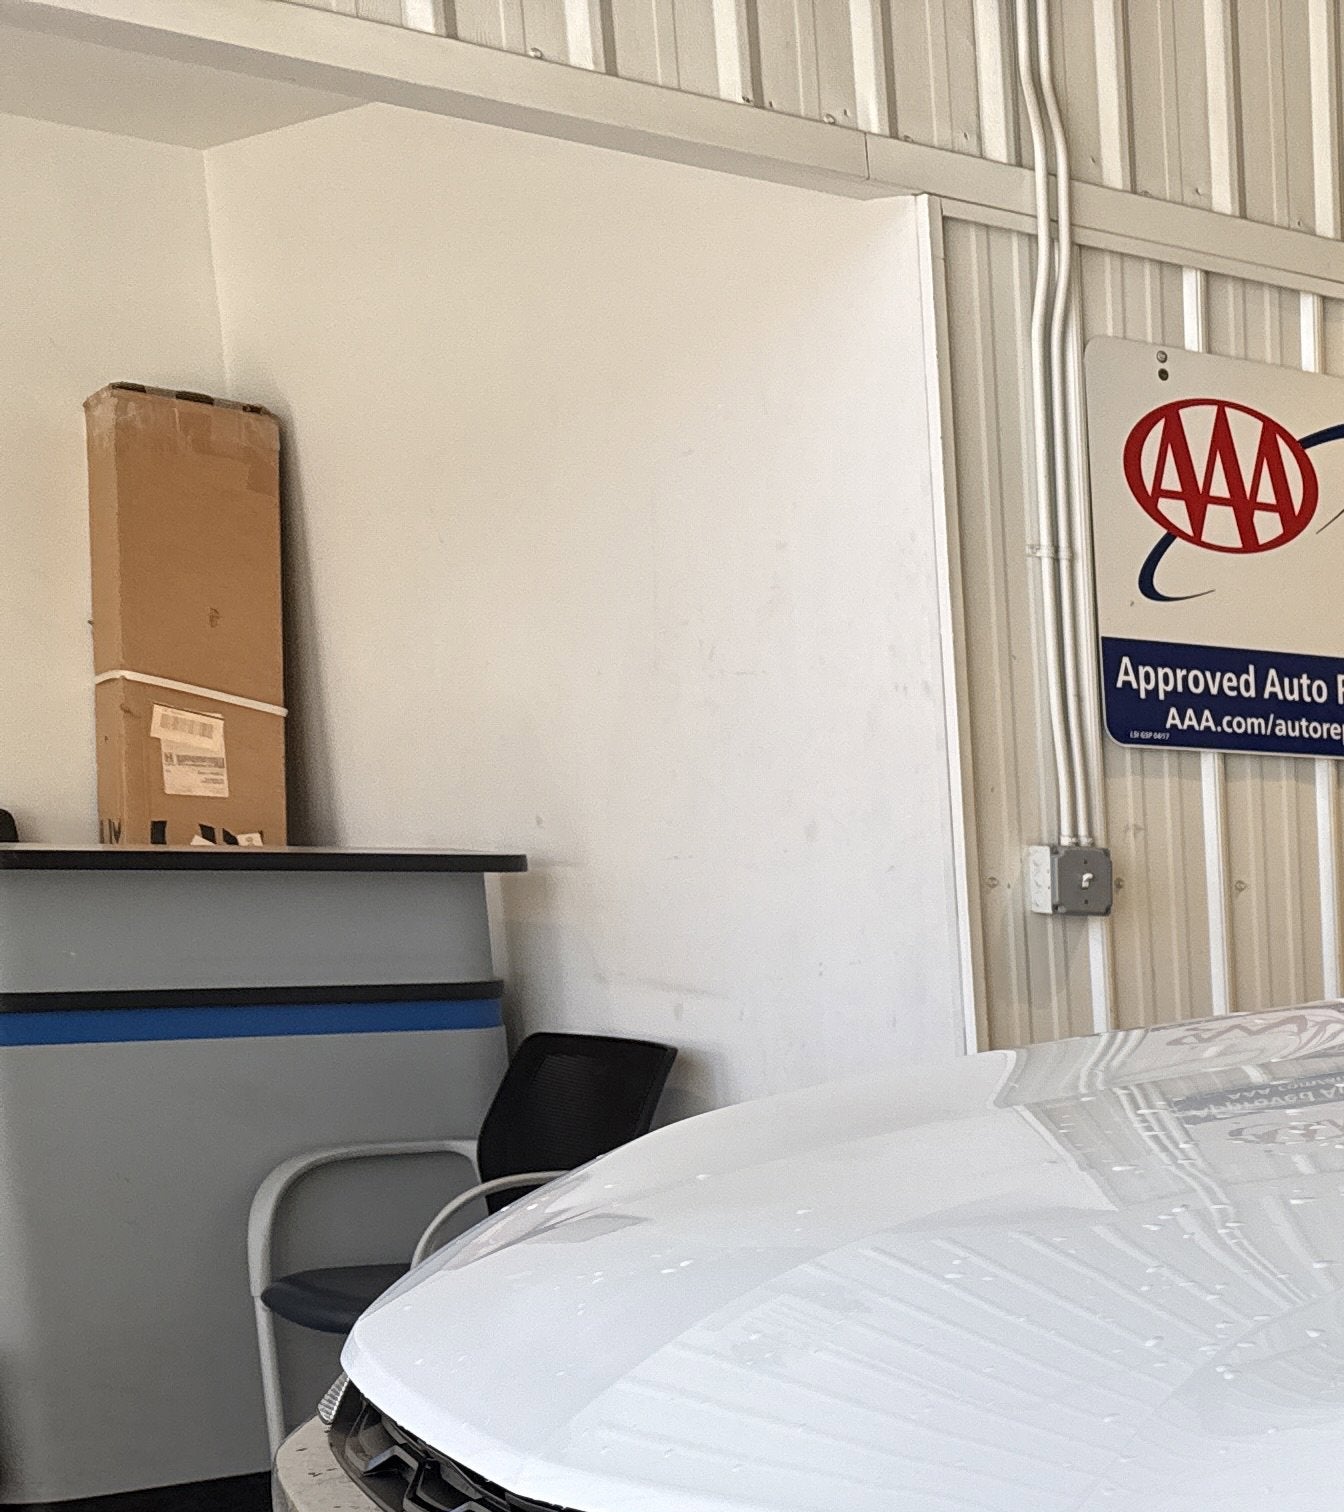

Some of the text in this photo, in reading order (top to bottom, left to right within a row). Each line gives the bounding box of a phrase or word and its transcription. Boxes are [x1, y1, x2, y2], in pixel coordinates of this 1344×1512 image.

[1148, 402, 1302, 551] AAA
[1116, 656, 1256, 700] Approved
[1264, 668, 1328, 703] Auto
